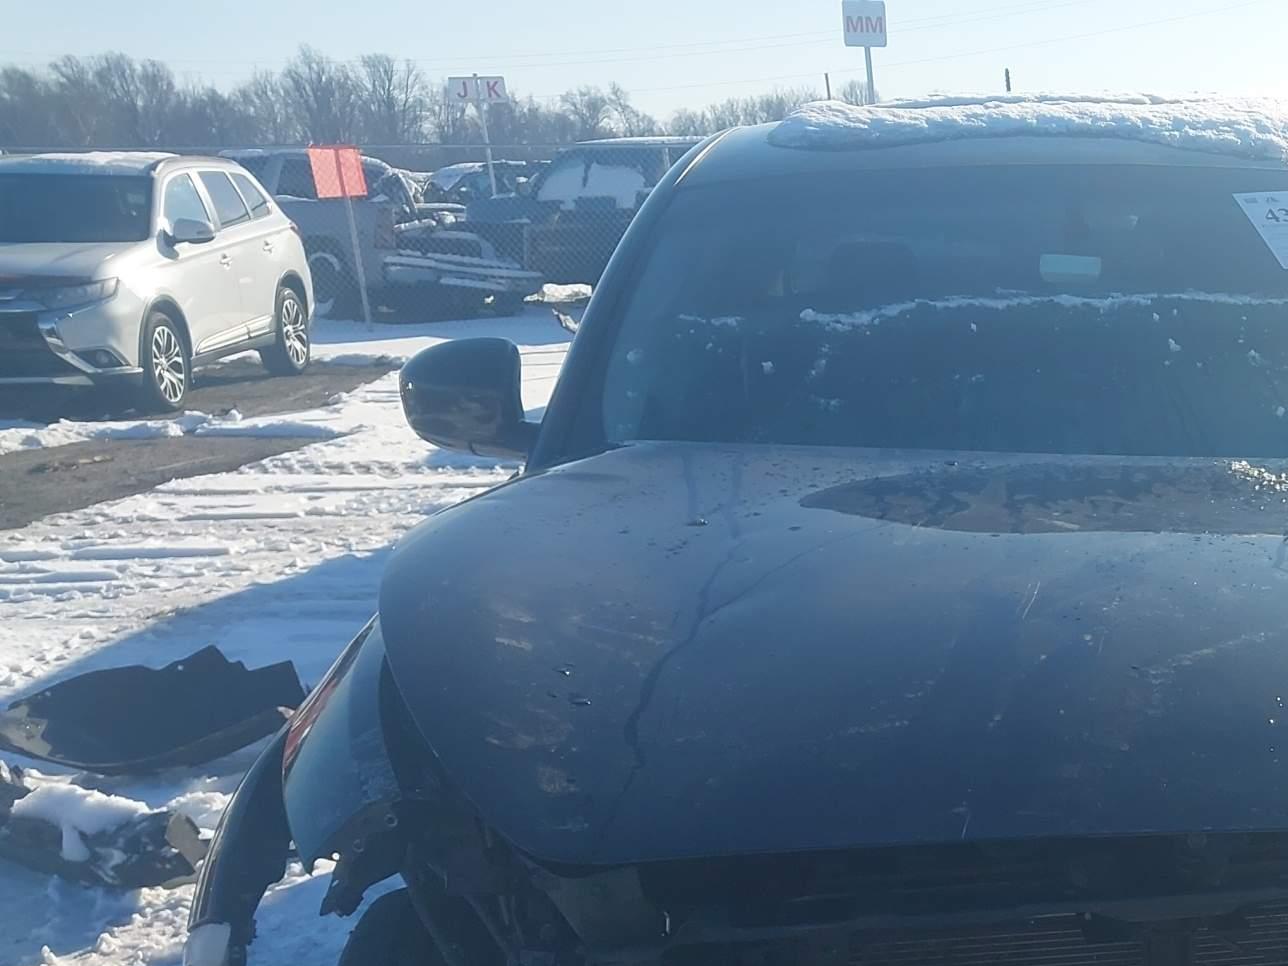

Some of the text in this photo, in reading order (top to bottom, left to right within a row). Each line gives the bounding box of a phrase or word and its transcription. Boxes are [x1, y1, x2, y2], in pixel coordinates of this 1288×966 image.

[846, 16, 883, 33] MM
[457, 81, 502, 98] J K
